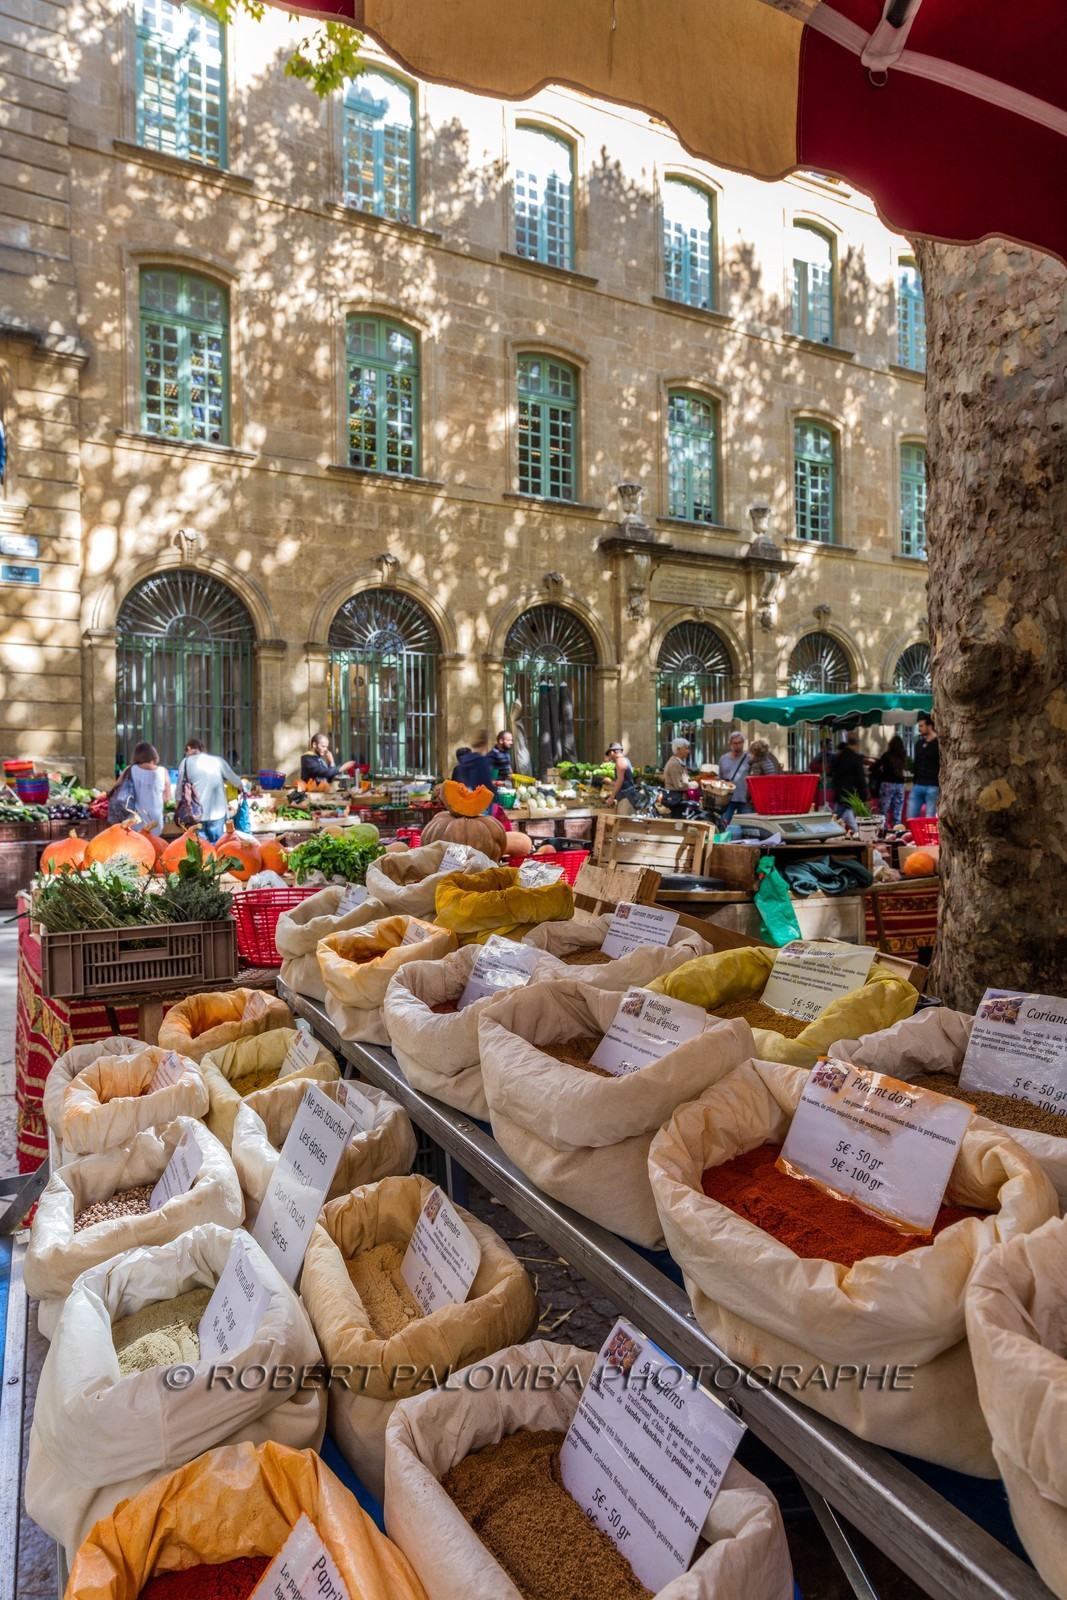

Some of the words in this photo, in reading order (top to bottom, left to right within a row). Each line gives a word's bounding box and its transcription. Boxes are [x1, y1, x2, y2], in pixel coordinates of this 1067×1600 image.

[642, 1012, 658, 1026] Pain
[657, 1016, 680, 1034] d'épices
[646, 1000, 672, 1015] Mélange
[851, 1077, 890, 1100] Pimnt
[1013, 1078, 1021, 1088] 5
[1023, 1080, 1032, 1090] €
[1039, 1084, 1055, 1096] 50
[305, 1092, 315, 1109] Ne
[312, 1104, 325, 1119] pas
[323, 1110, 347, 1140] toucher
[299, 1127, 310, 1146] Les
[308, 1137, 328, 1165] épices
[904, 1121, 917, 1131] dans
[923, 1129, 956, 1146] préparation
[836, 1140, 852, 1155] 5€
[856, 1149, 871, 1164] 50
[868, 1158, 884, 1170] gr
[830, 1157, 846, 1172] 9€
[850, 1167, 870, 1184] 100
[868, 1179, 884, 1190] gr
[289, 1200, 305, 1230] Touch
[440, 1208, 461, 1238] Gingembre
[272, 1222, 288, 1252] Spices
[586, 1417, 600, 1435] canard
[628, 1393, 652, 1420] traditionnel
[651, 1419, 665, 1436] d'Asie.
[672, 1440, 678, 1449] se
[679, 1447, 694, 1464] marie
[695, 1464, 708, 1478] avec
[708, 1475, 718, 1488] les
[631, 1382, 637, 1392] Le
[640, 1393, 659, 1415] parfums
[658, 1412, 665, 1421] ou
[664, 1416, 670, 1424] 5
[668, 1421, 685, 1440] épices
[684, 1437, 693, 1448] est
[692, 1445, 700, 1456] un
[700, 1453, 722, 1477] mélange
[616, 1396, 622, 1405] de
[624, 1404, 641, 1424] viandes
[642, 1422, 662, 1449] blanches,
[664, 1446, 673, 1458] les
[671, 1455, 692, 1478] poisson
[694, 1478, 702, 1488] et
[703, 1485, 713, 1499] les
[584, 1402, 607, 1428] accompagne
[606, 1425, 615, 1437] très
[614, 1433, 624, 1448] bien
[628, 1451, 640, 1467] plats
[639, 1464, 669, 1499] sucrés/salés
[667, 1496, 680, 1511] avec
[679, 1506, 686, 1518] le
[685, 1515, 699, 1533] porc
[571, 1423, 593, 1454] Composition
[594, 1452, 613, 1481] Coriandre,
[613, 1475, 628, 1499] fenouil,
[627, 1495, 637, 1511] anis,
[637, 1508, 657, 1534] cannelle,
[656, 1530, 674, 1552] poivre
[673, 1549, 685, 1568] noir,
[592, 1488, 606, 1508] 5€
[607, 1508, 621, 1528] 50
[619, 1525, 631, 1540] gr
[274, 1582, 286, 1600] ba
[280, 1563, 290, 1580] Le
[286, 1579, 306, 1600] papr
[312, 1555, 343, 1600] Papri
